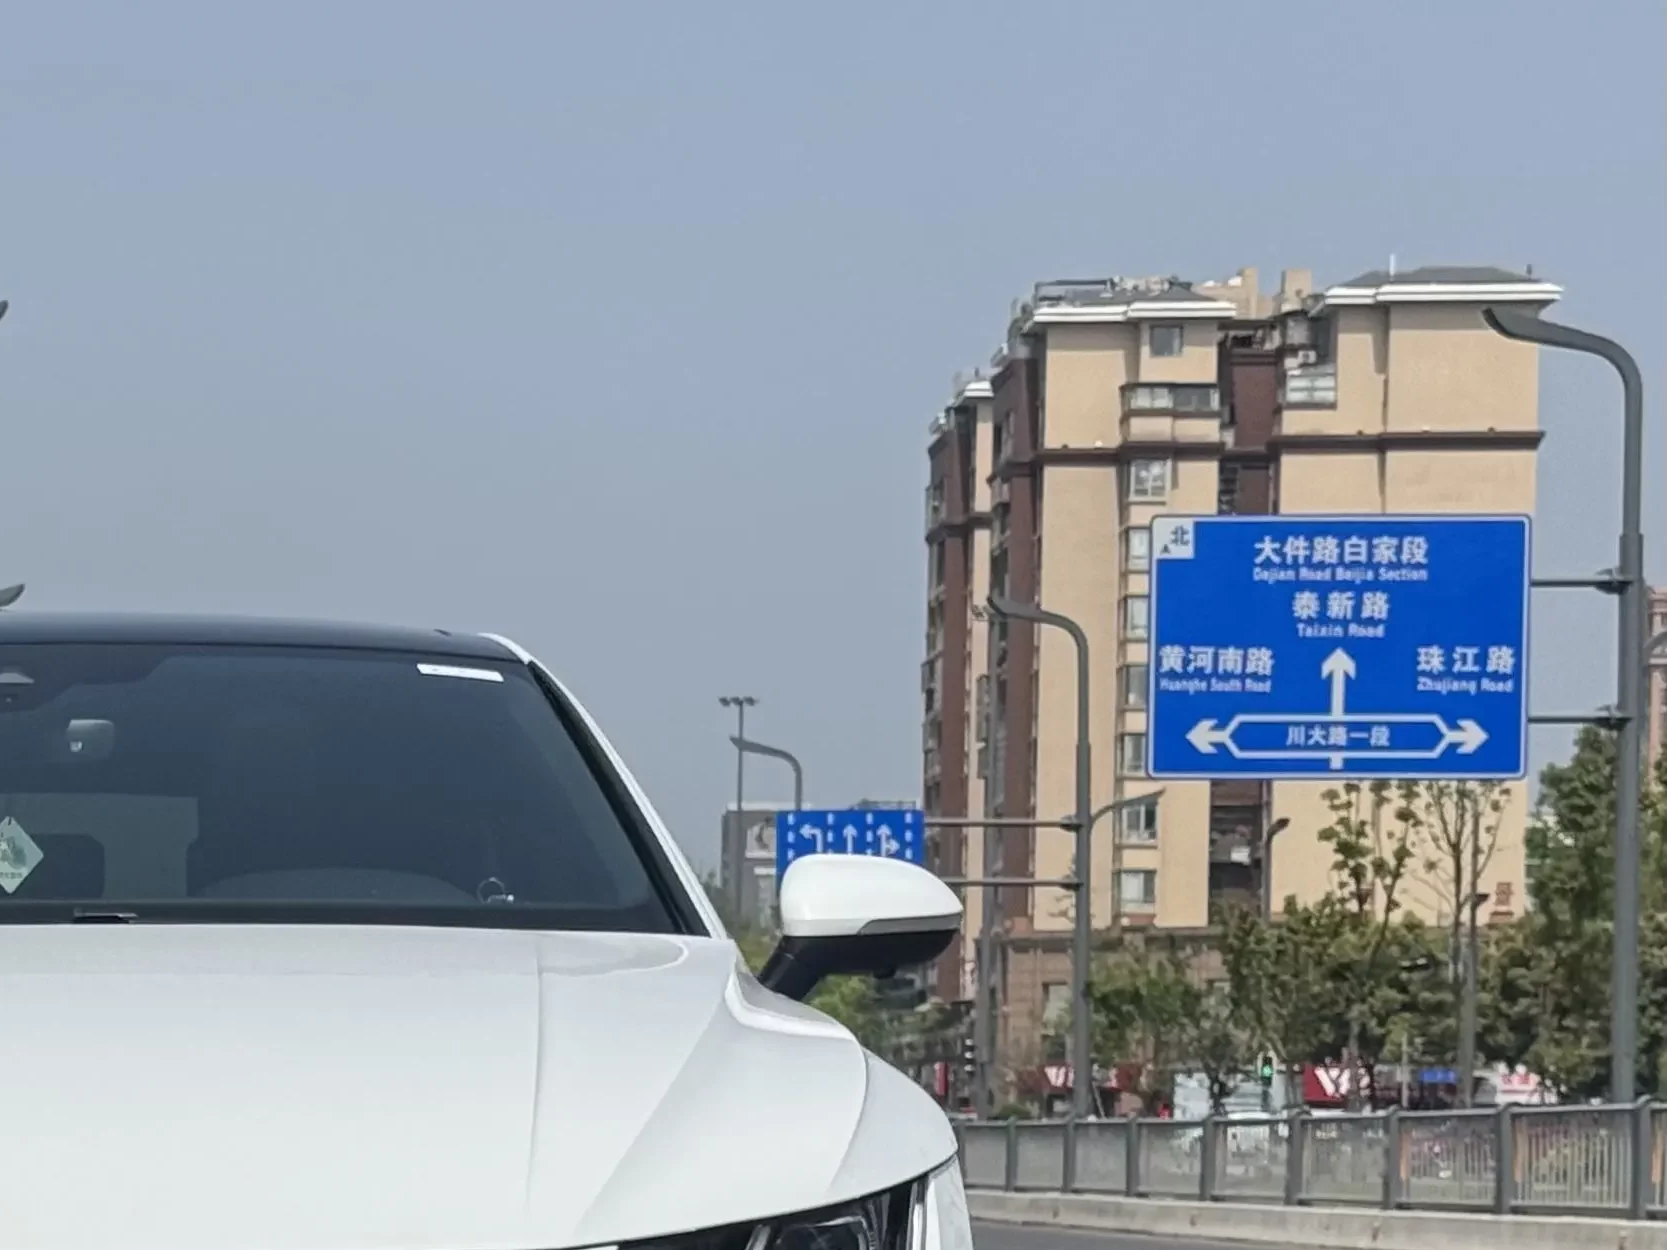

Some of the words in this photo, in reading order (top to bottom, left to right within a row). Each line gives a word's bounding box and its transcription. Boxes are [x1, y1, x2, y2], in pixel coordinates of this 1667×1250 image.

[1170, 524, 1191, 546] 北
[1253, 535, 1429, 565] 大件路白家段
[1298, 566, 1333, 582] Road
[1378, 566, 1429, 582] Section
[1292, 590, 1390, 620] 泰新路
[1348, 622, 1385, 638] Road
[1159, 645, 1275, 676] 黄河南路
[1417, 645, 1516, 675] 珠江路
[1244, 677, 1272, 693] Road
[1416, 676, 1478, 696] Zhujiang
[1480, 677, 1514, 692] Road
[1285, 723, 1391, 748] 川大路一段
